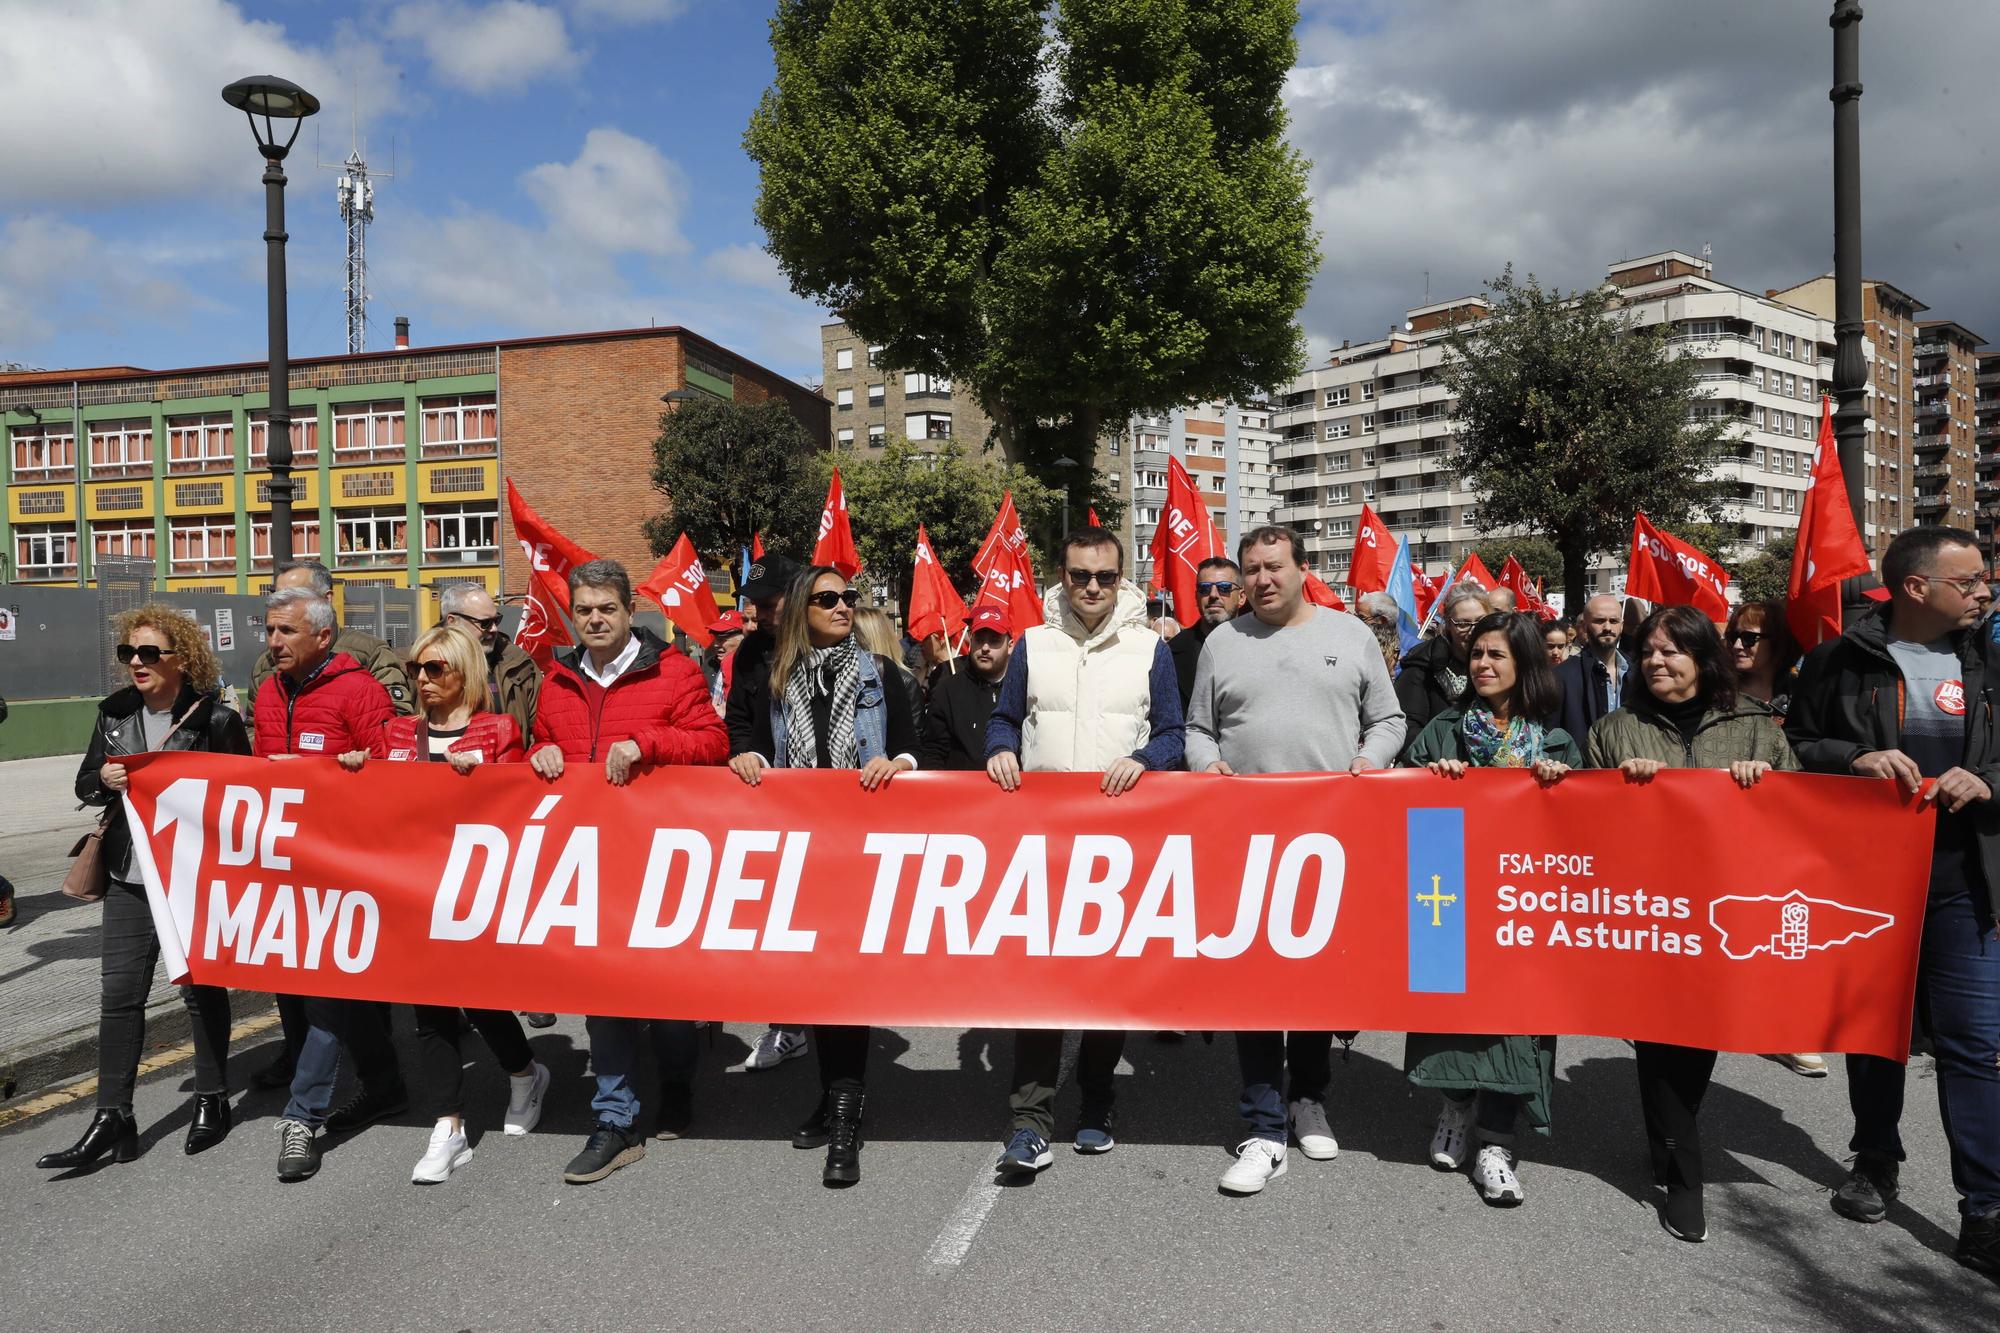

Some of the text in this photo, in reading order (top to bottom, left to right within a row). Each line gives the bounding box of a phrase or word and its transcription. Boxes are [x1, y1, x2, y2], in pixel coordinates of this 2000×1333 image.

[153, 778, 208, 958] 1
[218, 785, 304, 870] DE
[1499, 853, 1594, 876] FSA-PSOE
[430, 795, 1346, 959] DÍA DEL TRABAJO
[1497, 885, 1690, 919] Socialistas
[203, 880, 380, 973] MAYO
[1496, 919, 1702, 956] de Asturias
